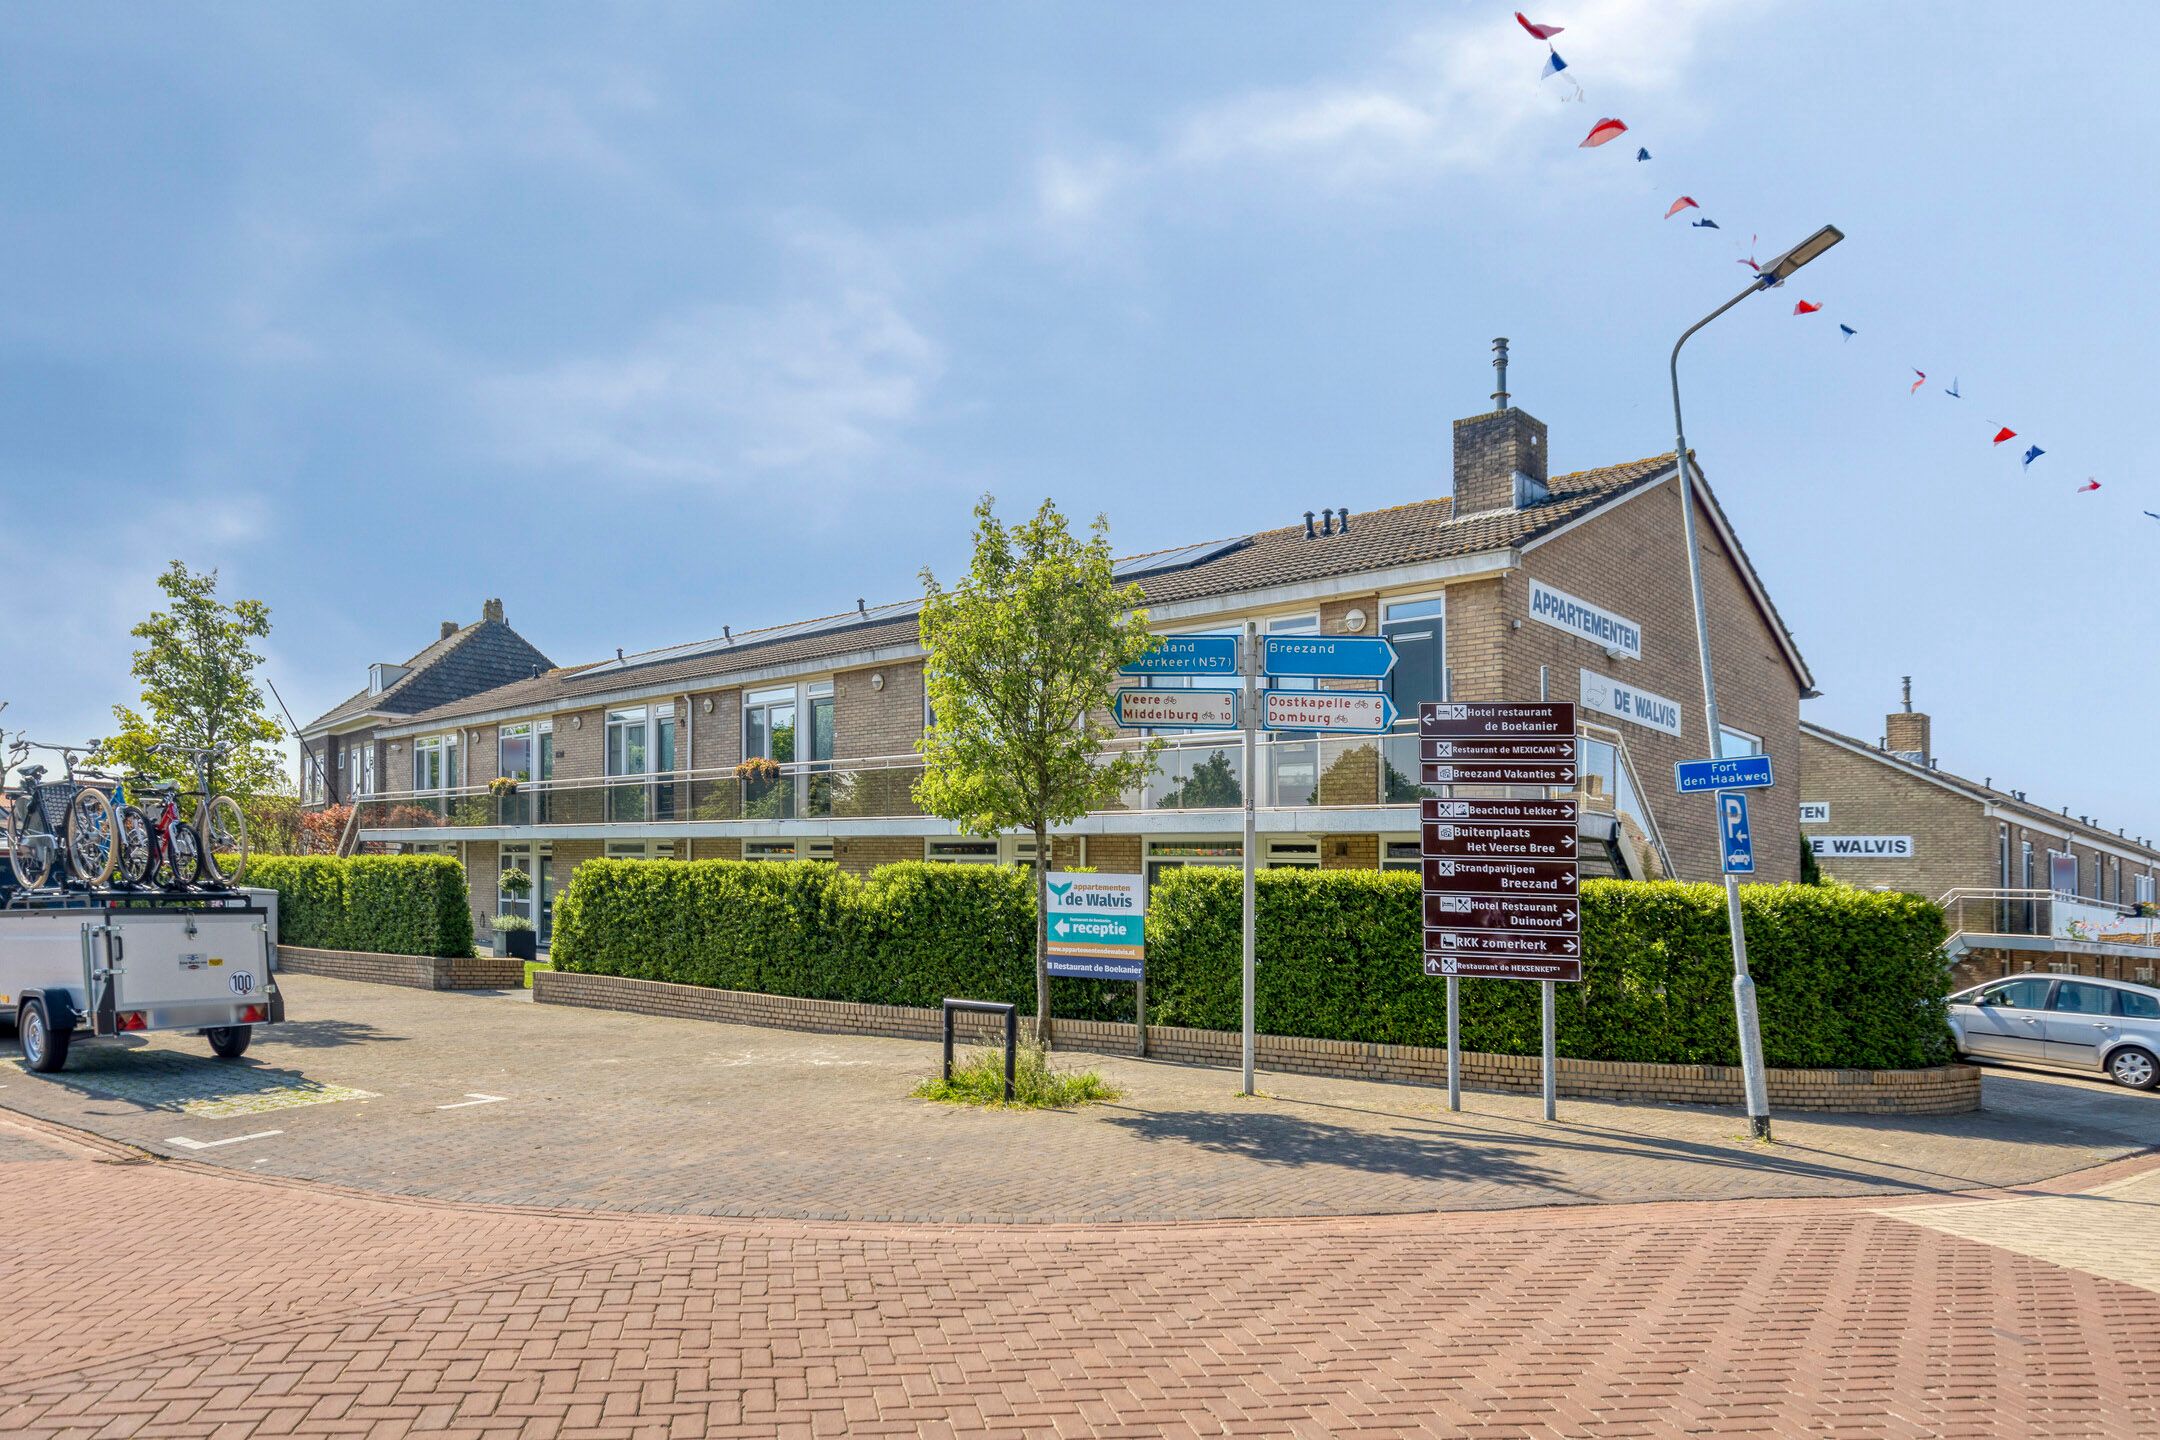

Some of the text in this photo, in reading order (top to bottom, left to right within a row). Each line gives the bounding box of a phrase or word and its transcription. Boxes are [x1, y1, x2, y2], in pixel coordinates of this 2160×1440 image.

[1532, 588, 1639, 651] APPARTEMENTEN
[1269, 643, 1335, 654] Breezand
[1123, 694, 1231, 706] Veere 5
[1269, 697, 1382, 710] Oostkapelle 6
[1467, 708, 1552, 717] Hotel restaurant
[1614, 688, 1676, 728] DE WALVIS
[1123, 709, 1231, 722] Middelburg 10
[1269, 712, 1381, 725] Domburg 9
[1485, 722, 1558, 731] de Boekanier
[1452, 746, 1556, 754] Restaurant de MEXICAAN
[1453, 769, 1556, 779] Breezand Vakanties
[1711, 763, 1737, 773] Fort
[1684, 772, 1768, 786] den Haakweg
[1469, 806, 1558, 816] Beachclub Lekker
[1726, 799, 1742, 839] P
[1454, 827, 1530, 839] Buitenplaats
[1467, 842, 1556, 853] Het Veerse Bree
[1833, 840, 1907, 854] WALVIS
[1455, 864, 1535, 876] Strandpaviljoen
[1073, 883, 1131, 892] appartementen
[1501, 878, 1558, 889] Breezand
[1065, 892, 1132, 908] de Walvis
[1471, 901, 1558, 912] Hotel Restaurant
[1510, 916, 1563, 927] Duinoord
[1072, 921, 1127, 937] receptie
[1456, 937, 1548, 951] RKK zomerkerk
[1053, 962, 1142, 974] Restaurant de Boekanier
[1457, 962, 1498, 971] Restaurant
[232, 974, 252, 991] 100
